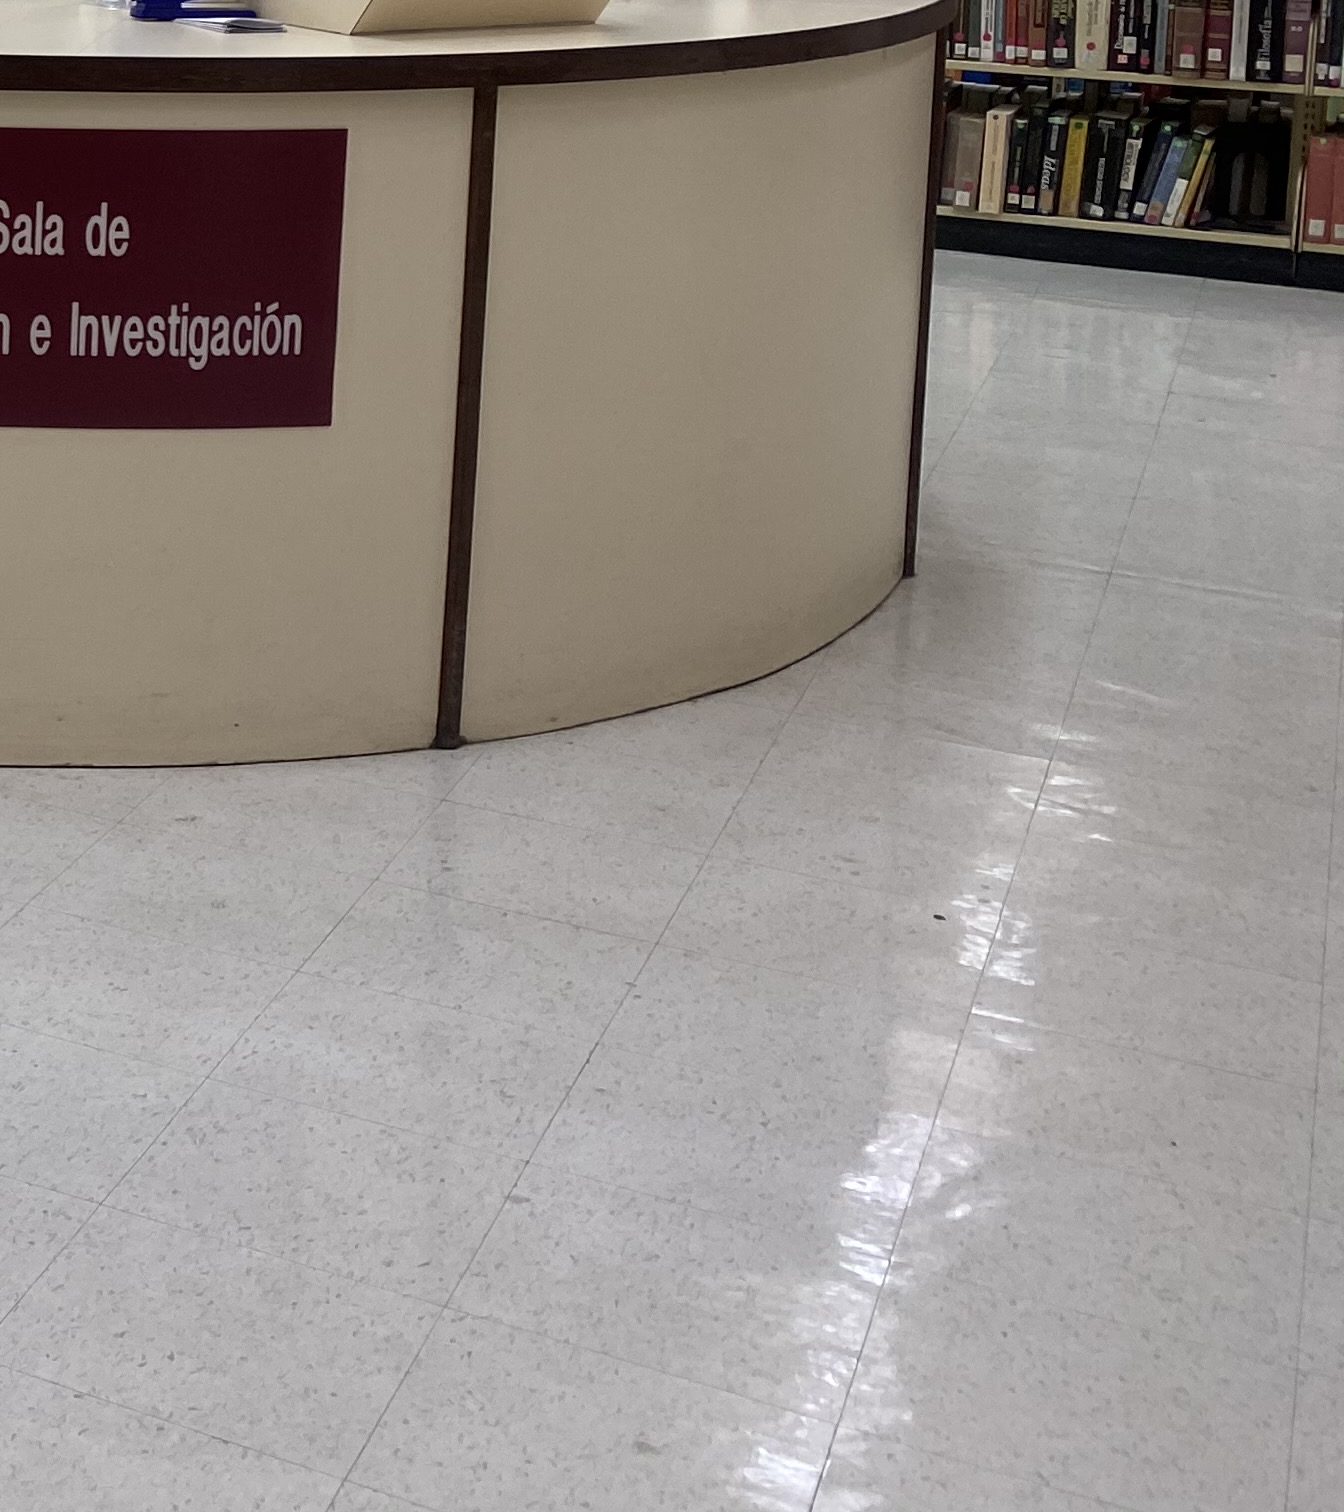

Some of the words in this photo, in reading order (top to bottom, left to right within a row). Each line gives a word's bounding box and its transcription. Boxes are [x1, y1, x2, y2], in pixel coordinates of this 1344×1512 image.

[1041, 155, 1056, 190] Ideas
[85, 202, 130, 257] de
[29, 311, 52, 352] e
[70, 301, 303, 370] Investigación
